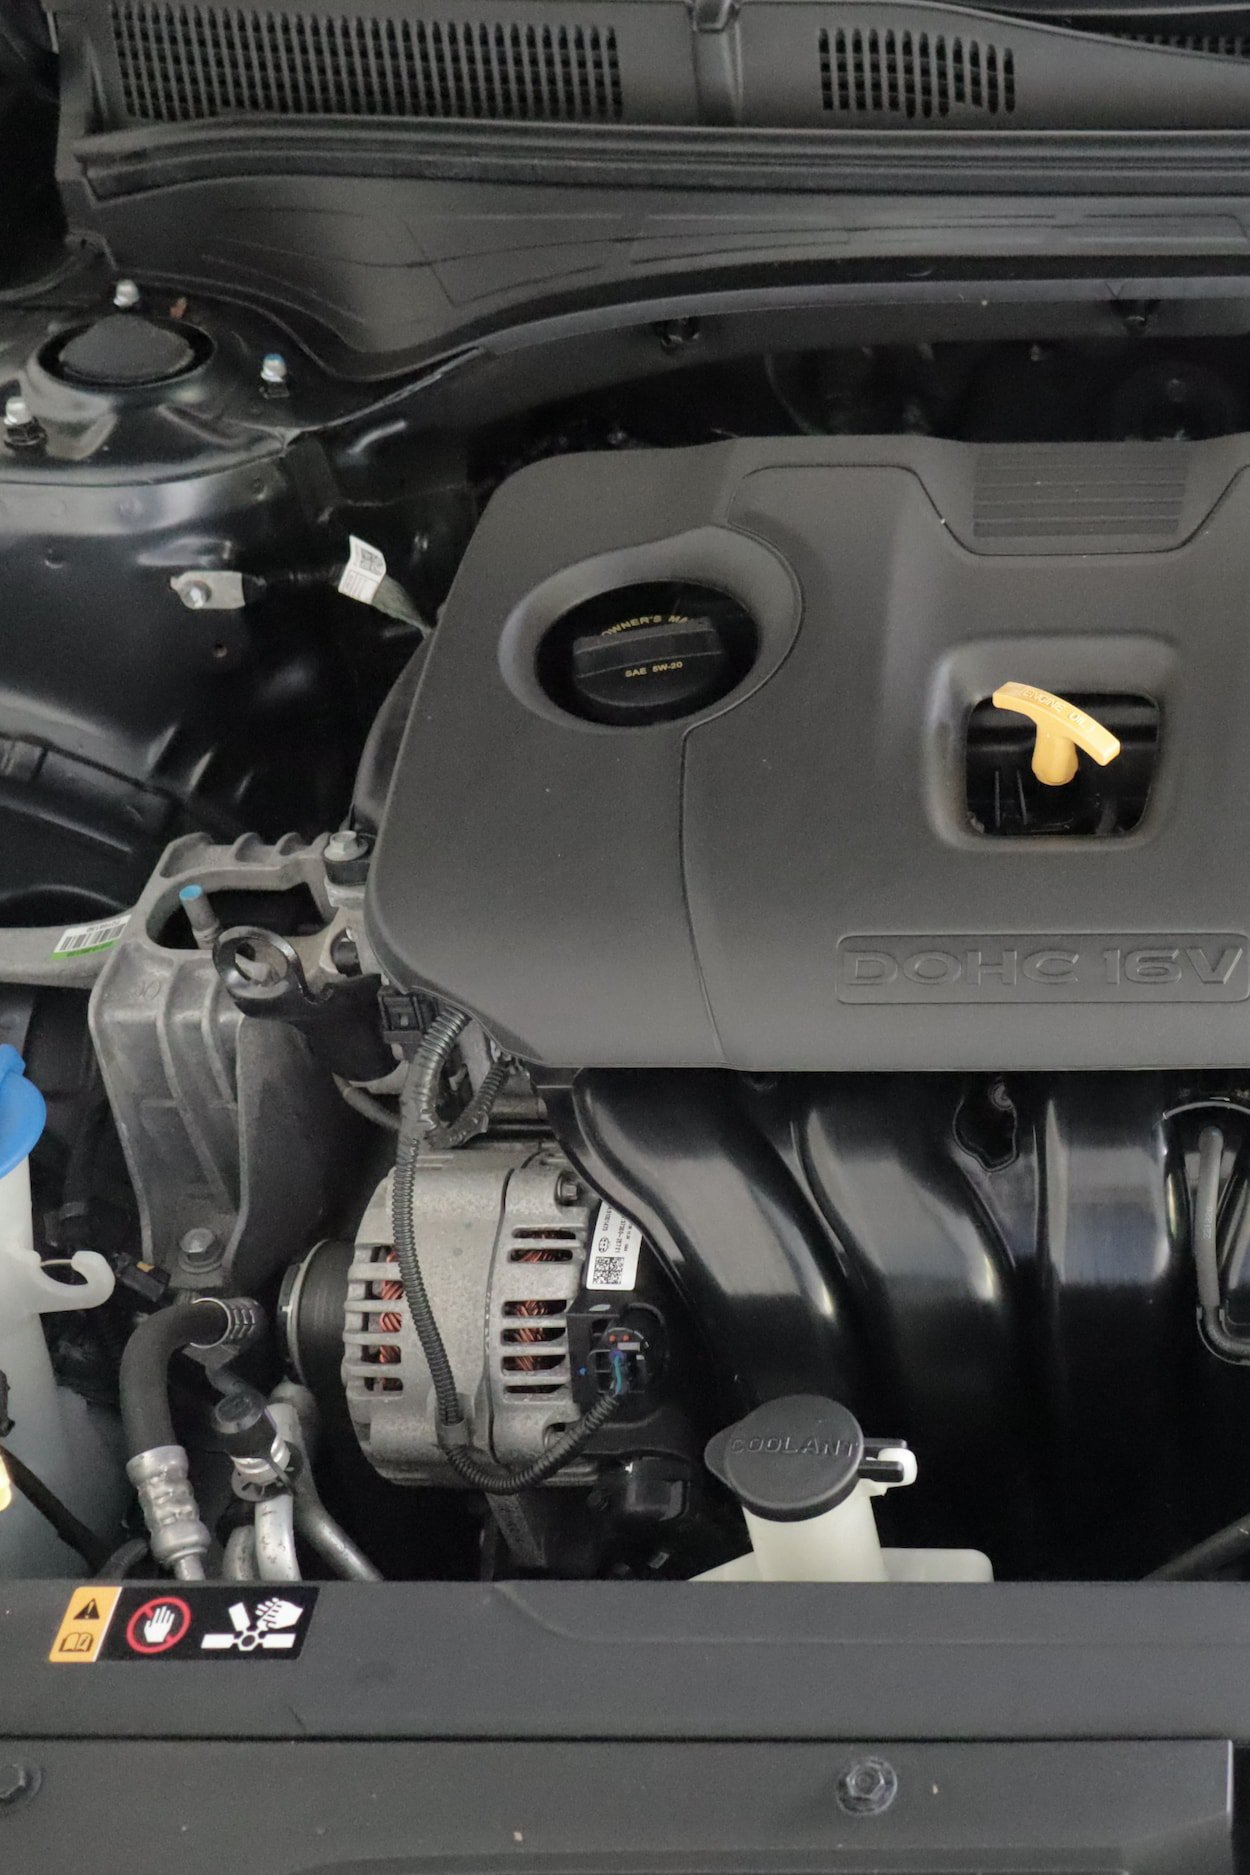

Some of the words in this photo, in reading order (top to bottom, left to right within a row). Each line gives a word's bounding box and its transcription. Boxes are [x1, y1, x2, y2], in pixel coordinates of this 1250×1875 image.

[625, 668, 648, 678] SAE
[652, 661, 684, 673] 5W-20
[843, 949, 1080, 986] DOHC
[1103, 947, 1244, 985] 16V
[730, 1435, 859, 1458] COOLANT
